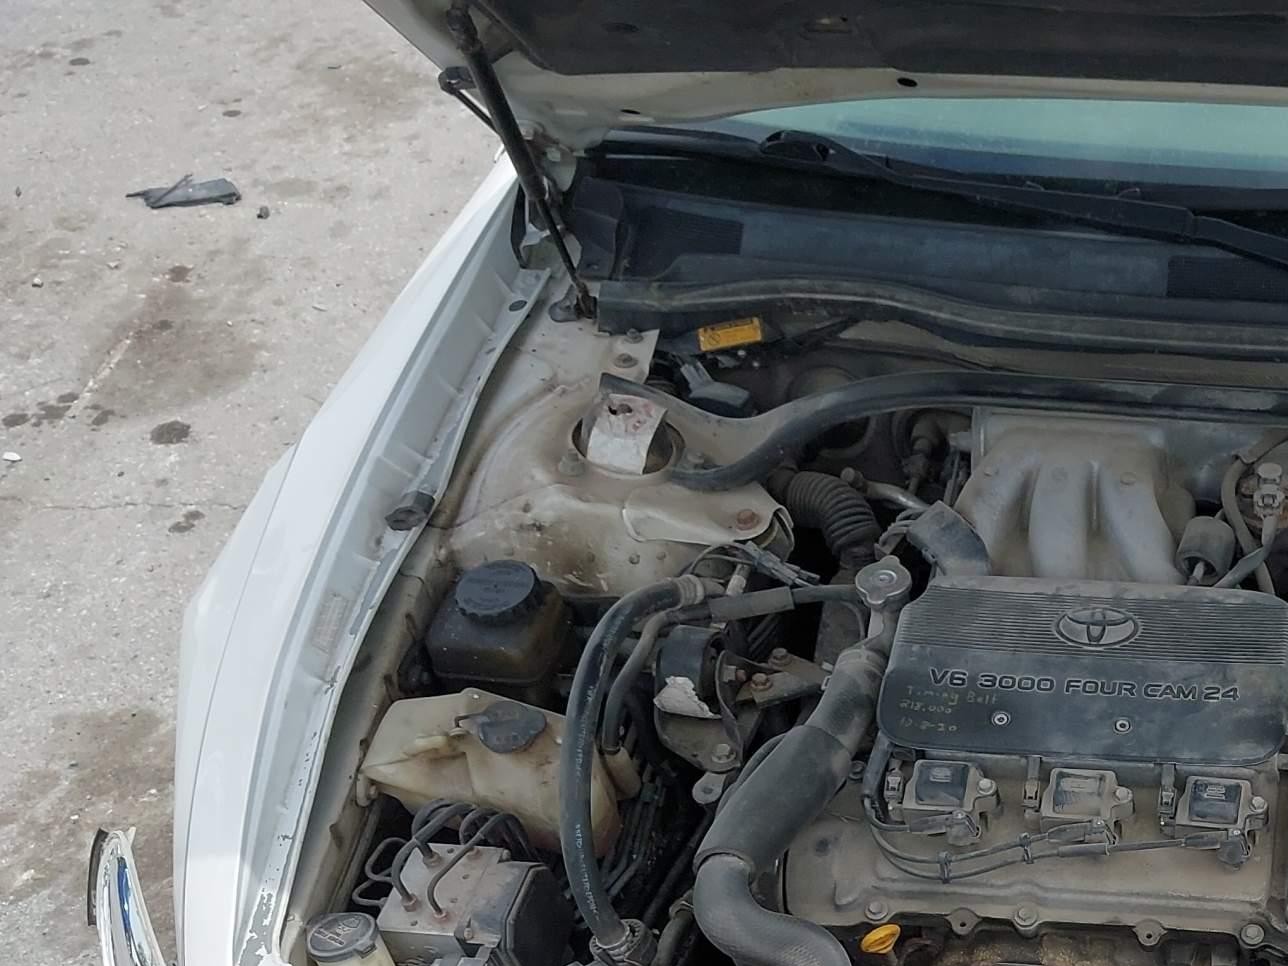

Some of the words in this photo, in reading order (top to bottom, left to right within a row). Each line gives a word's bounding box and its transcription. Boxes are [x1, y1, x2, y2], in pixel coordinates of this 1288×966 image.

[929, 666, 969, 689] V6
[977, 672, 1056, 694] 3000
[1064, 677, 1138, 698] FOUR
[1143, 682, 1199, 701] CAM
[1203, 684, 1241, 703] 24
